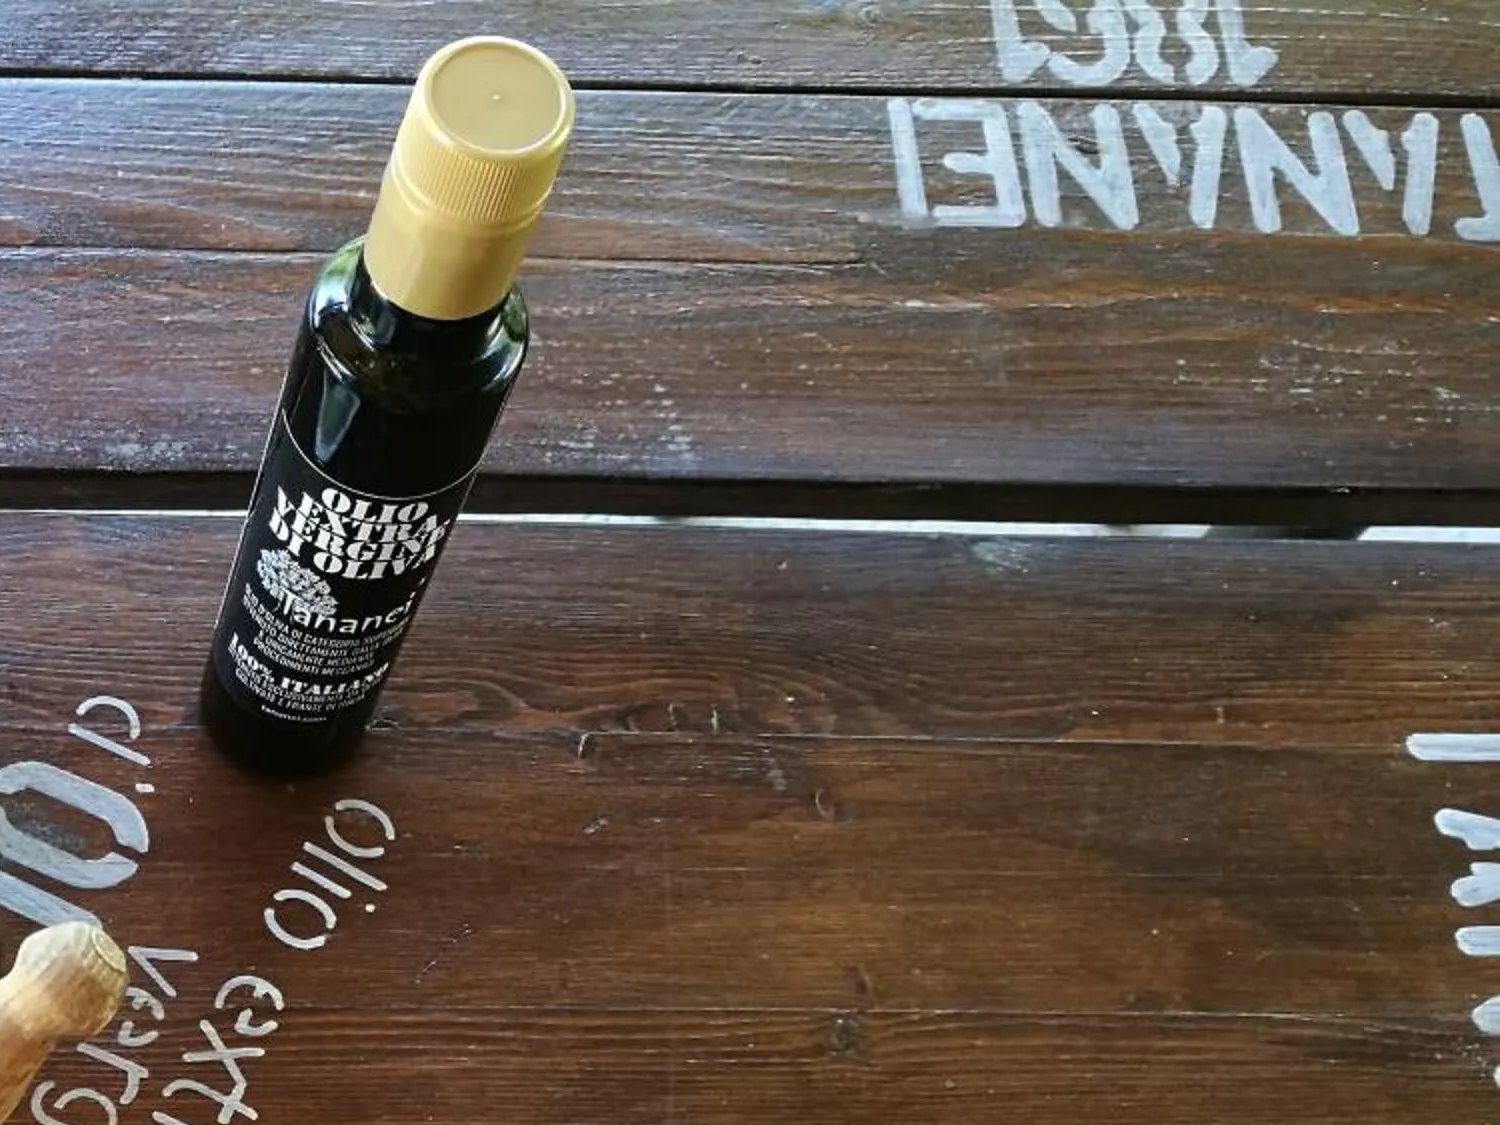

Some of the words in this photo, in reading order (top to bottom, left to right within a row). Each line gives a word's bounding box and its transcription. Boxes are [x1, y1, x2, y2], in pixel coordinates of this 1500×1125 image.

[301, 491, 437, 543] EXTRA
[322, 487, 429, 524] OLIO
[268, 507, 305, 557] DI
[313, 544, 437, 579] OLIVA
[263, 799, 396, 951] olio
